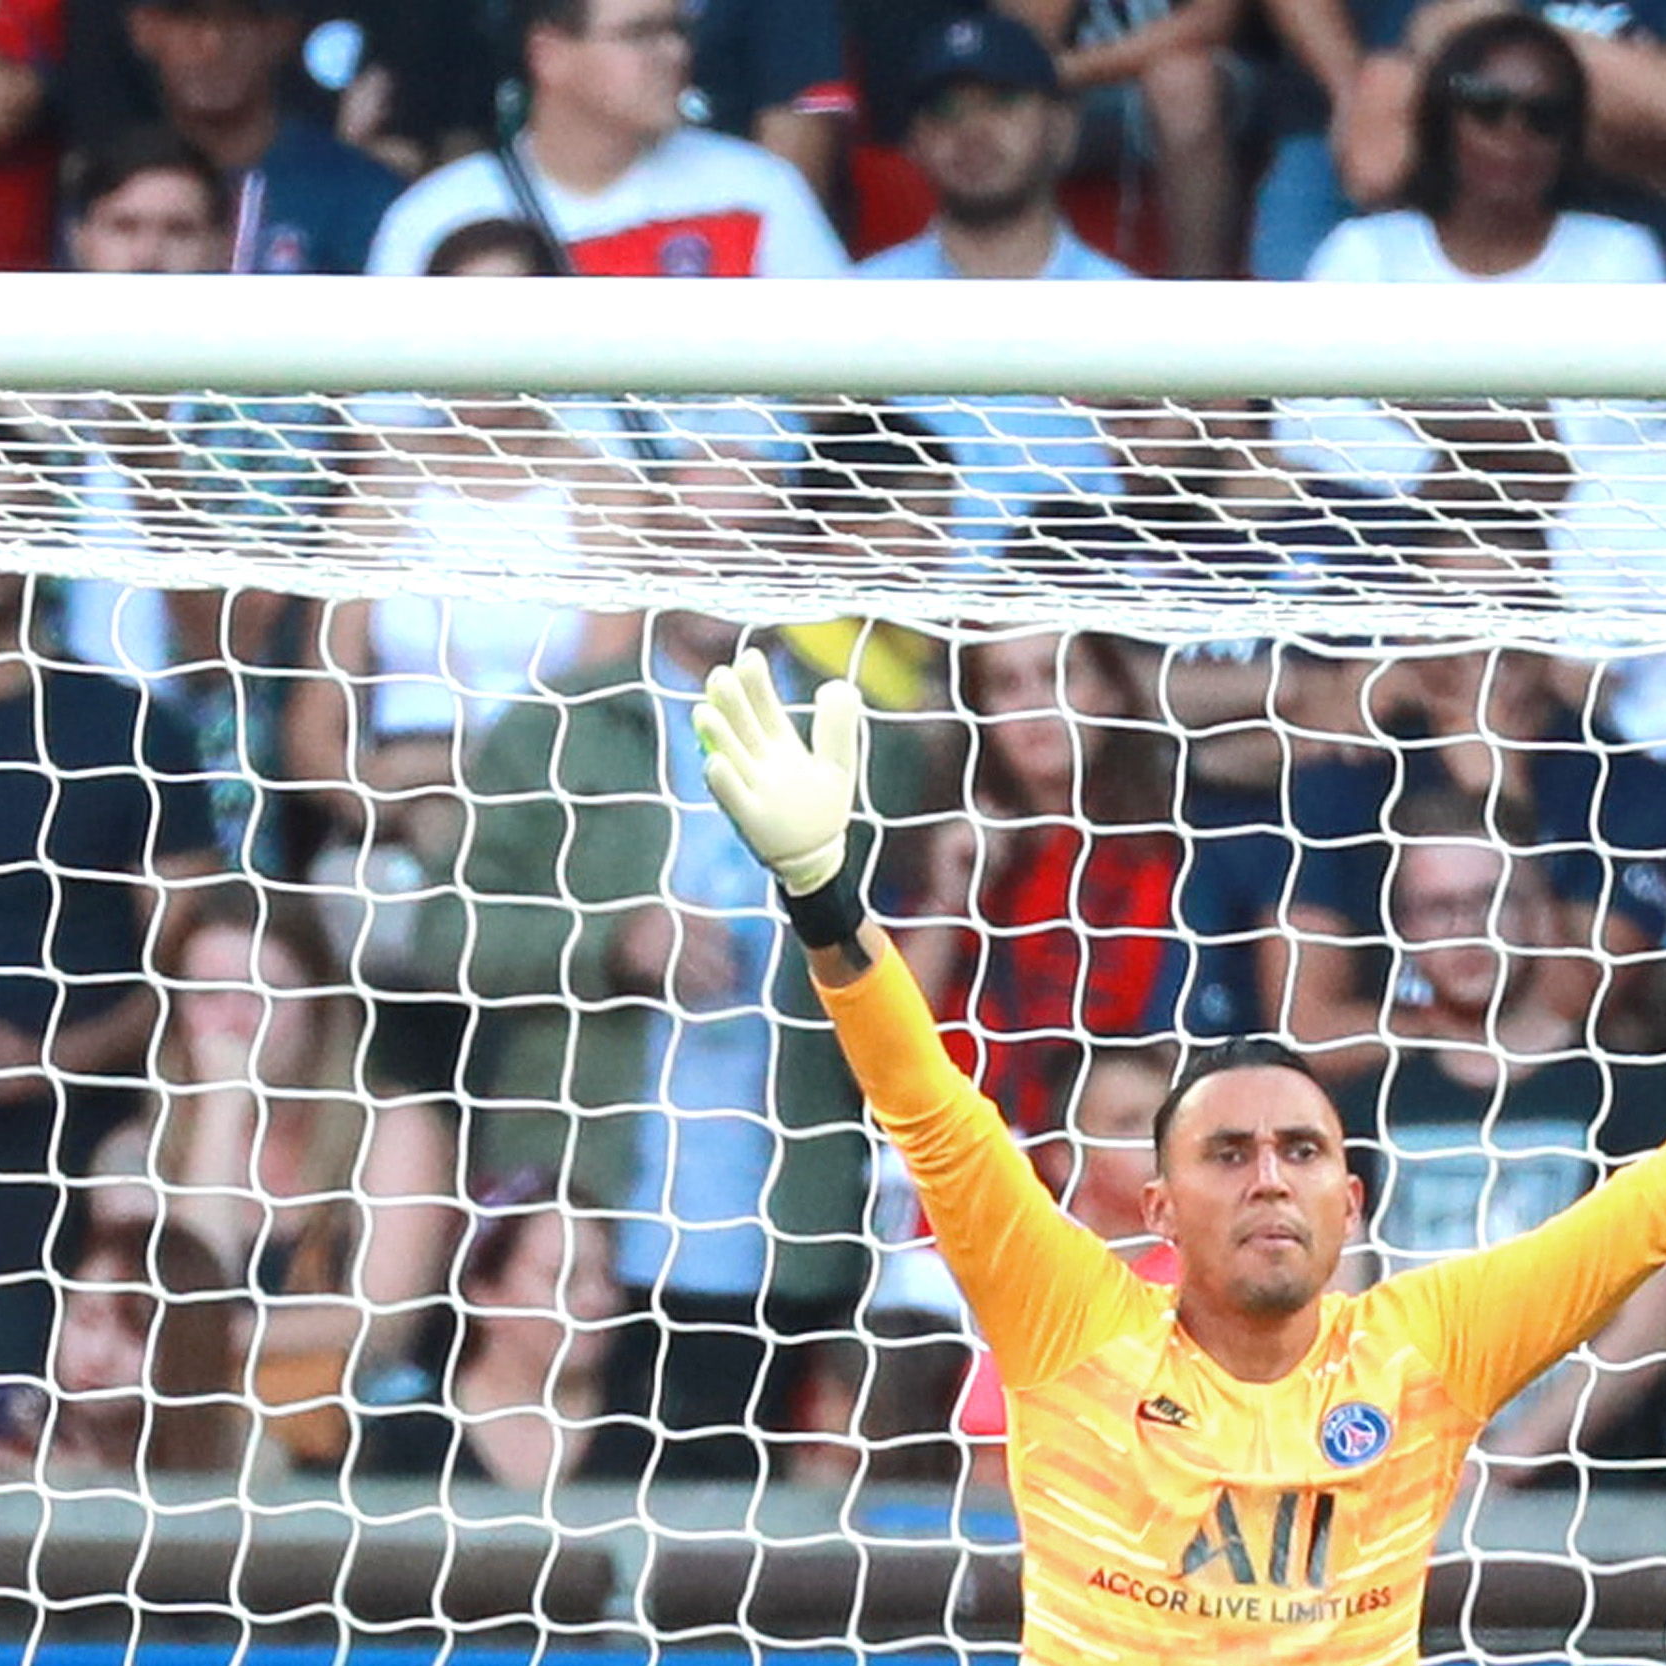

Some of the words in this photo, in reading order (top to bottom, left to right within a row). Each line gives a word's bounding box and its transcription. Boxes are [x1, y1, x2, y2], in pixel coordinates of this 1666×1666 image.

[1088, 1567, 1189, 1615] ACCOR
[1197, 1595, 1262, 1622] LIVE
[1270, 1585, 1392, 1624] LIMITLESS
